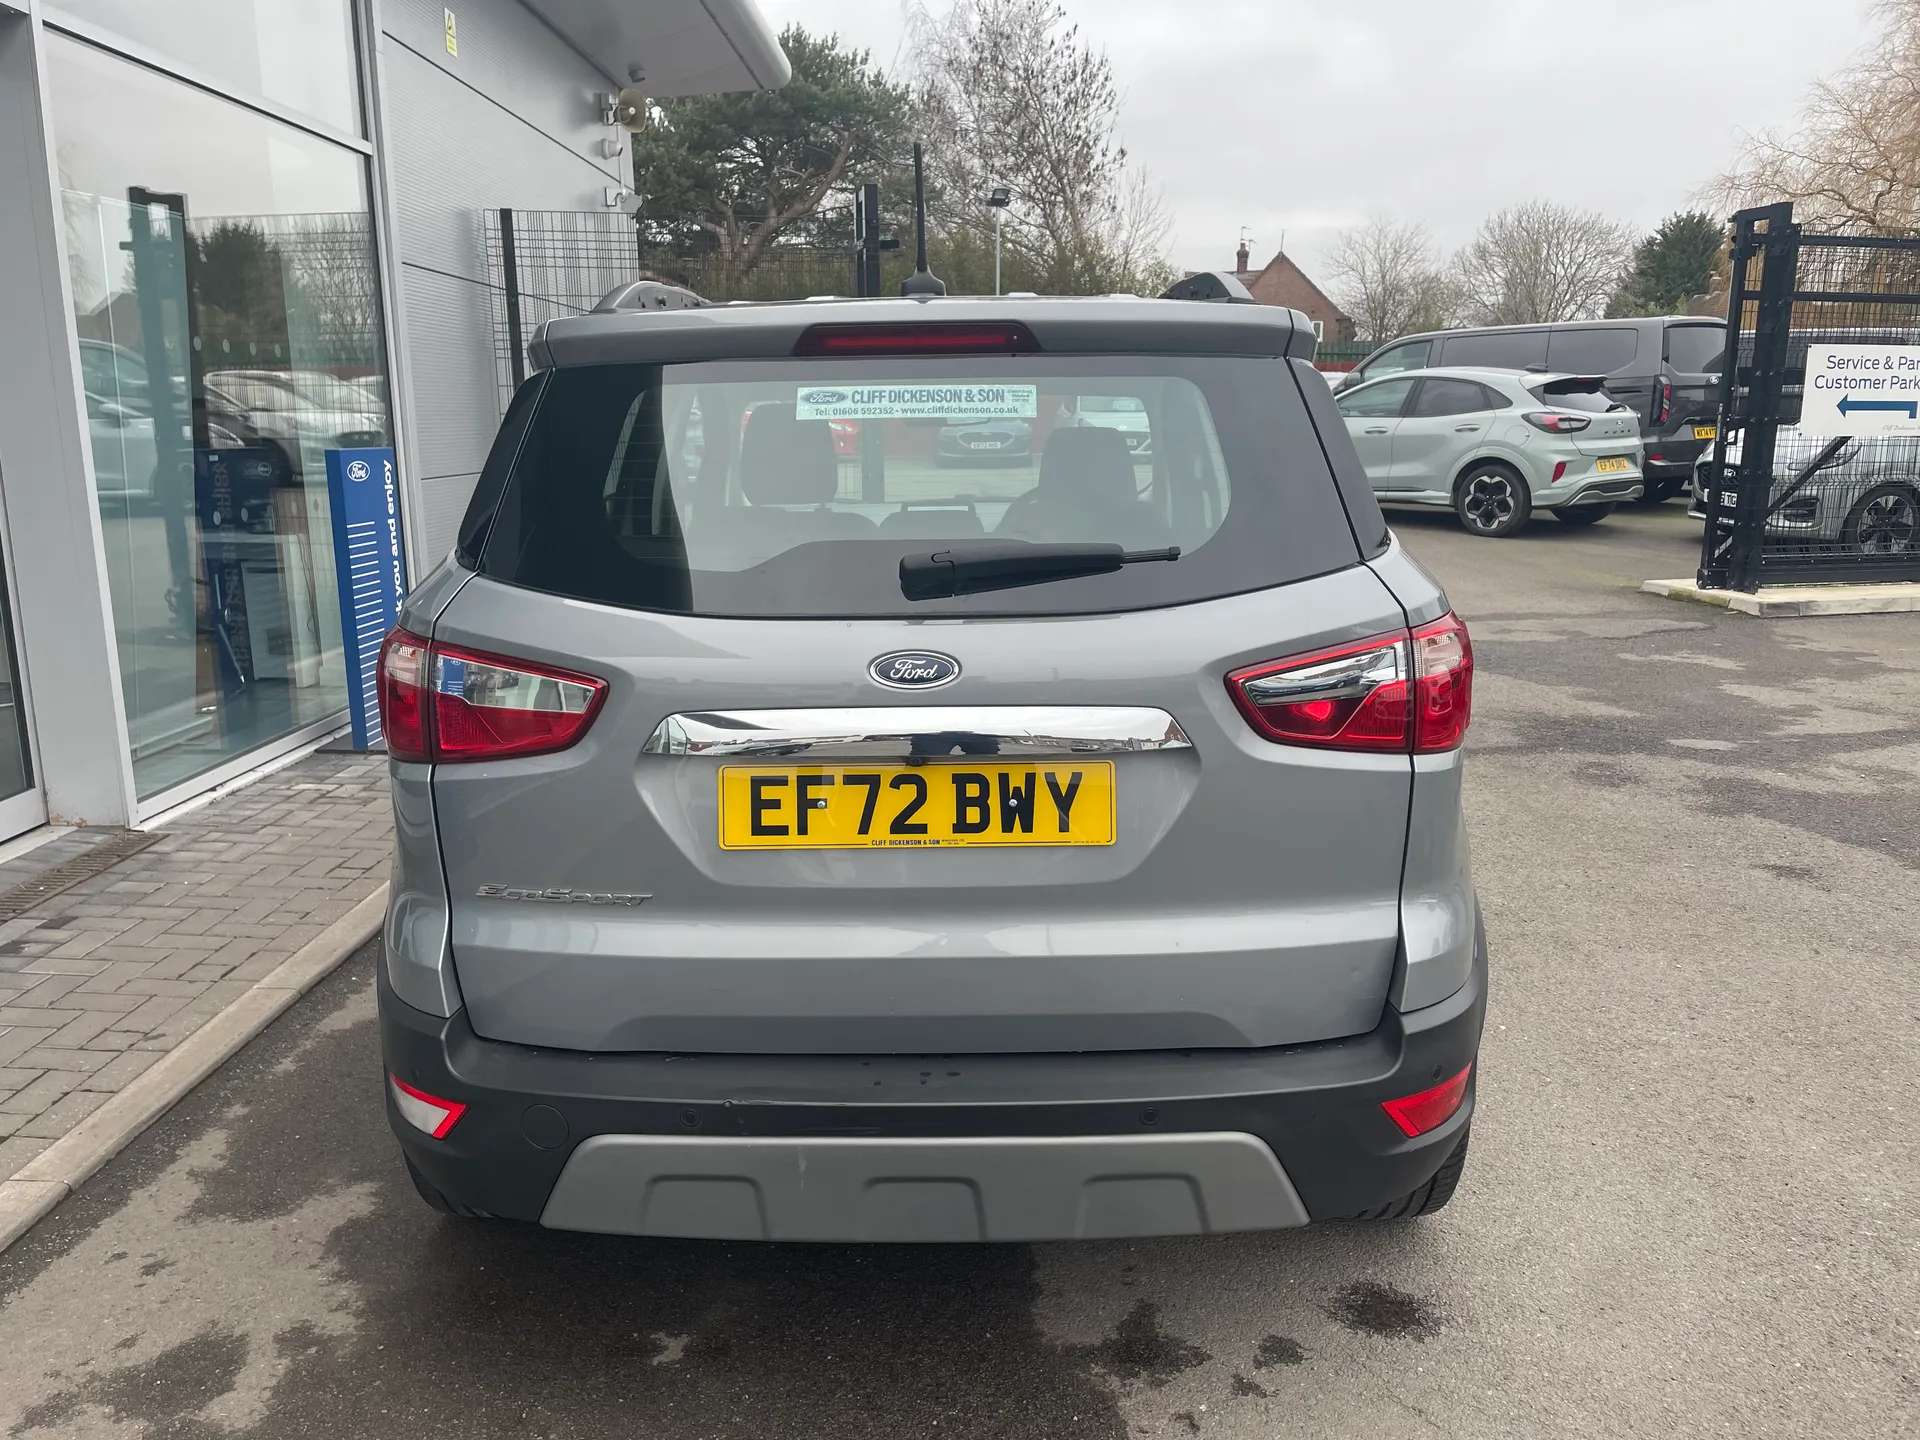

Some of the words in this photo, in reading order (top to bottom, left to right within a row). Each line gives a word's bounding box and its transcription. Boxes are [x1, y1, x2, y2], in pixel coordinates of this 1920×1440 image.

[1826, 354, 1880, 370] Service
[1883, 355, 1894, 370] &
[1814, 374, 1887, 390] Customer
[851, 390, 887, 404] CLIFF
[888, 388, 962, 403] DICKENSON
[964, 388, 977, 402] &
[978, 388, 1005, 402] SON
[351, 463, 367, 479] Ford
[384, 460, 394, 514] enjoy
[388, 518, 398, 557] and
[393, 561, 403, 600] you
[889, 659, 939, 680] Ford
[750, 773, 929, 837] EF72
[951, 772, 1083, 834] BWY
